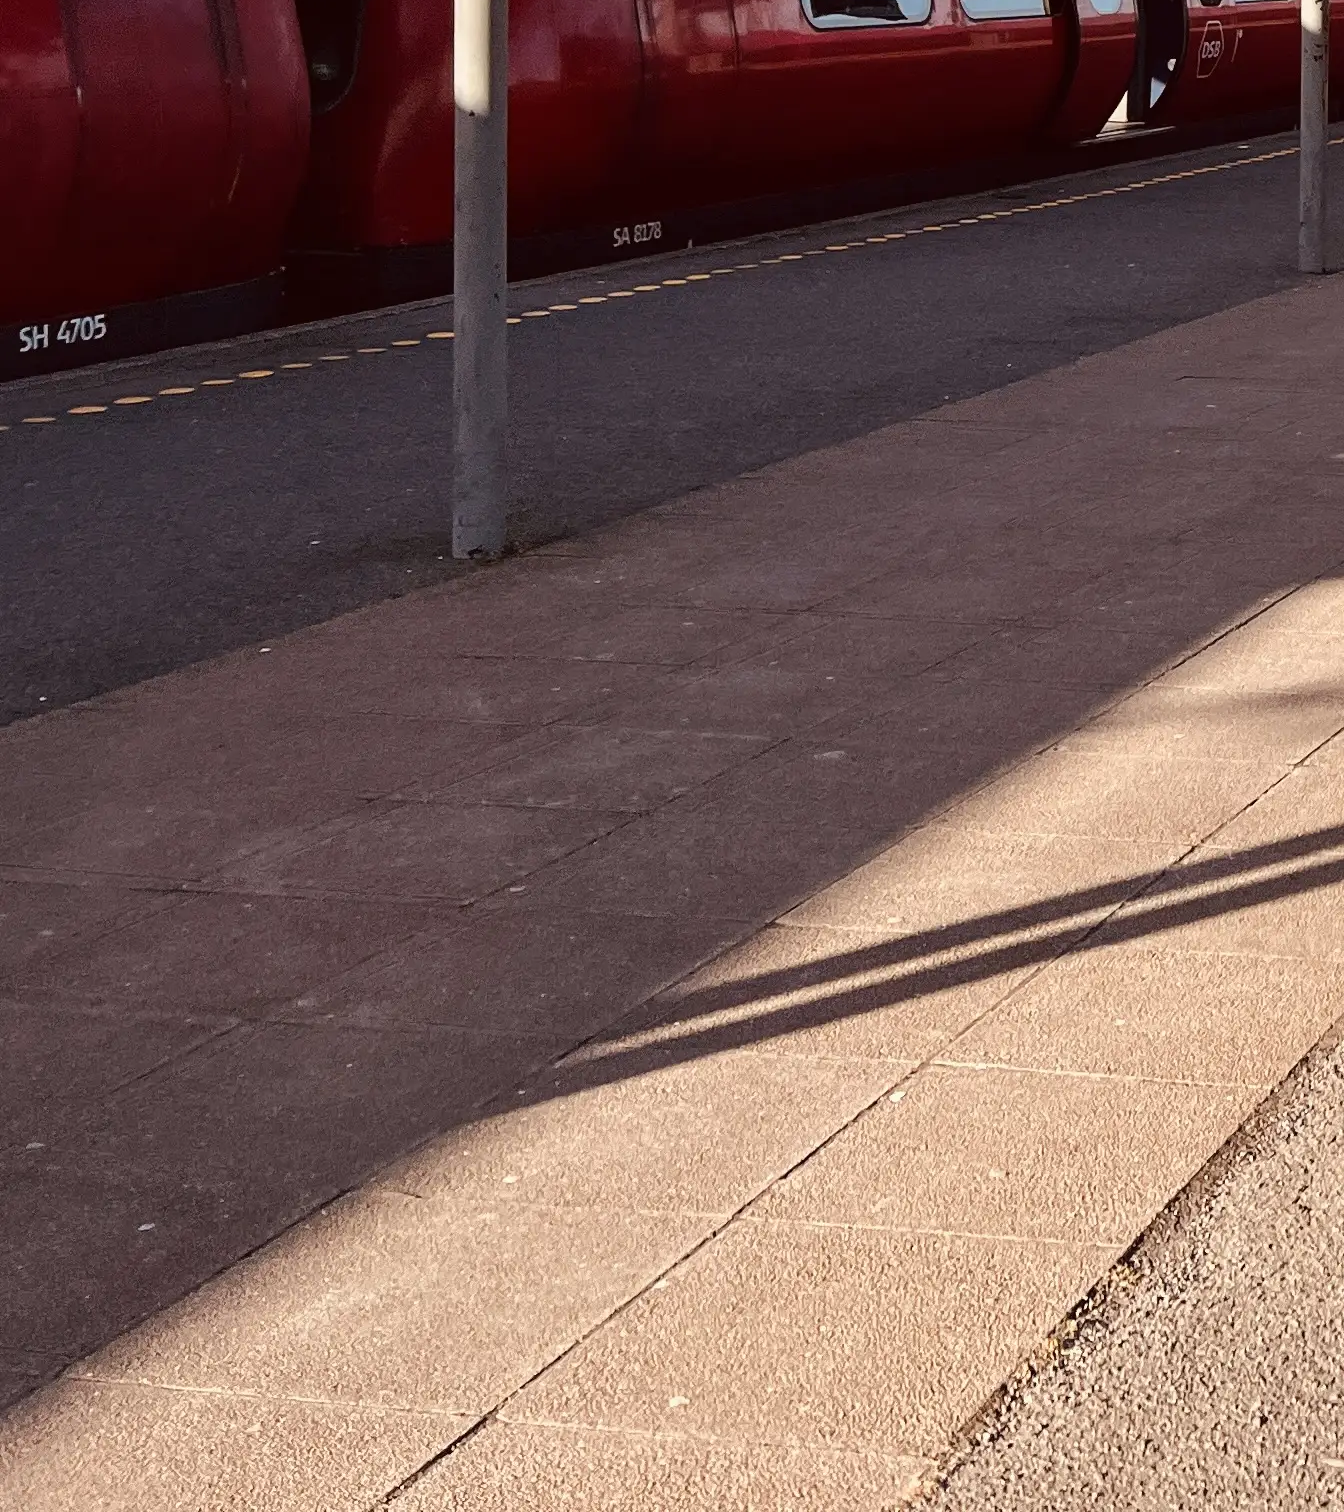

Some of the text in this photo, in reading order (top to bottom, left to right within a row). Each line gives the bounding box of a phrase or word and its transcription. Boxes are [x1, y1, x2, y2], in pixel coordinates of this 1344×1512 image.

[1202, 41, 1221, 58] DSB
[613, 221, 662, 248] SA 8178
[20, 314, 107, 353] SH 4705
